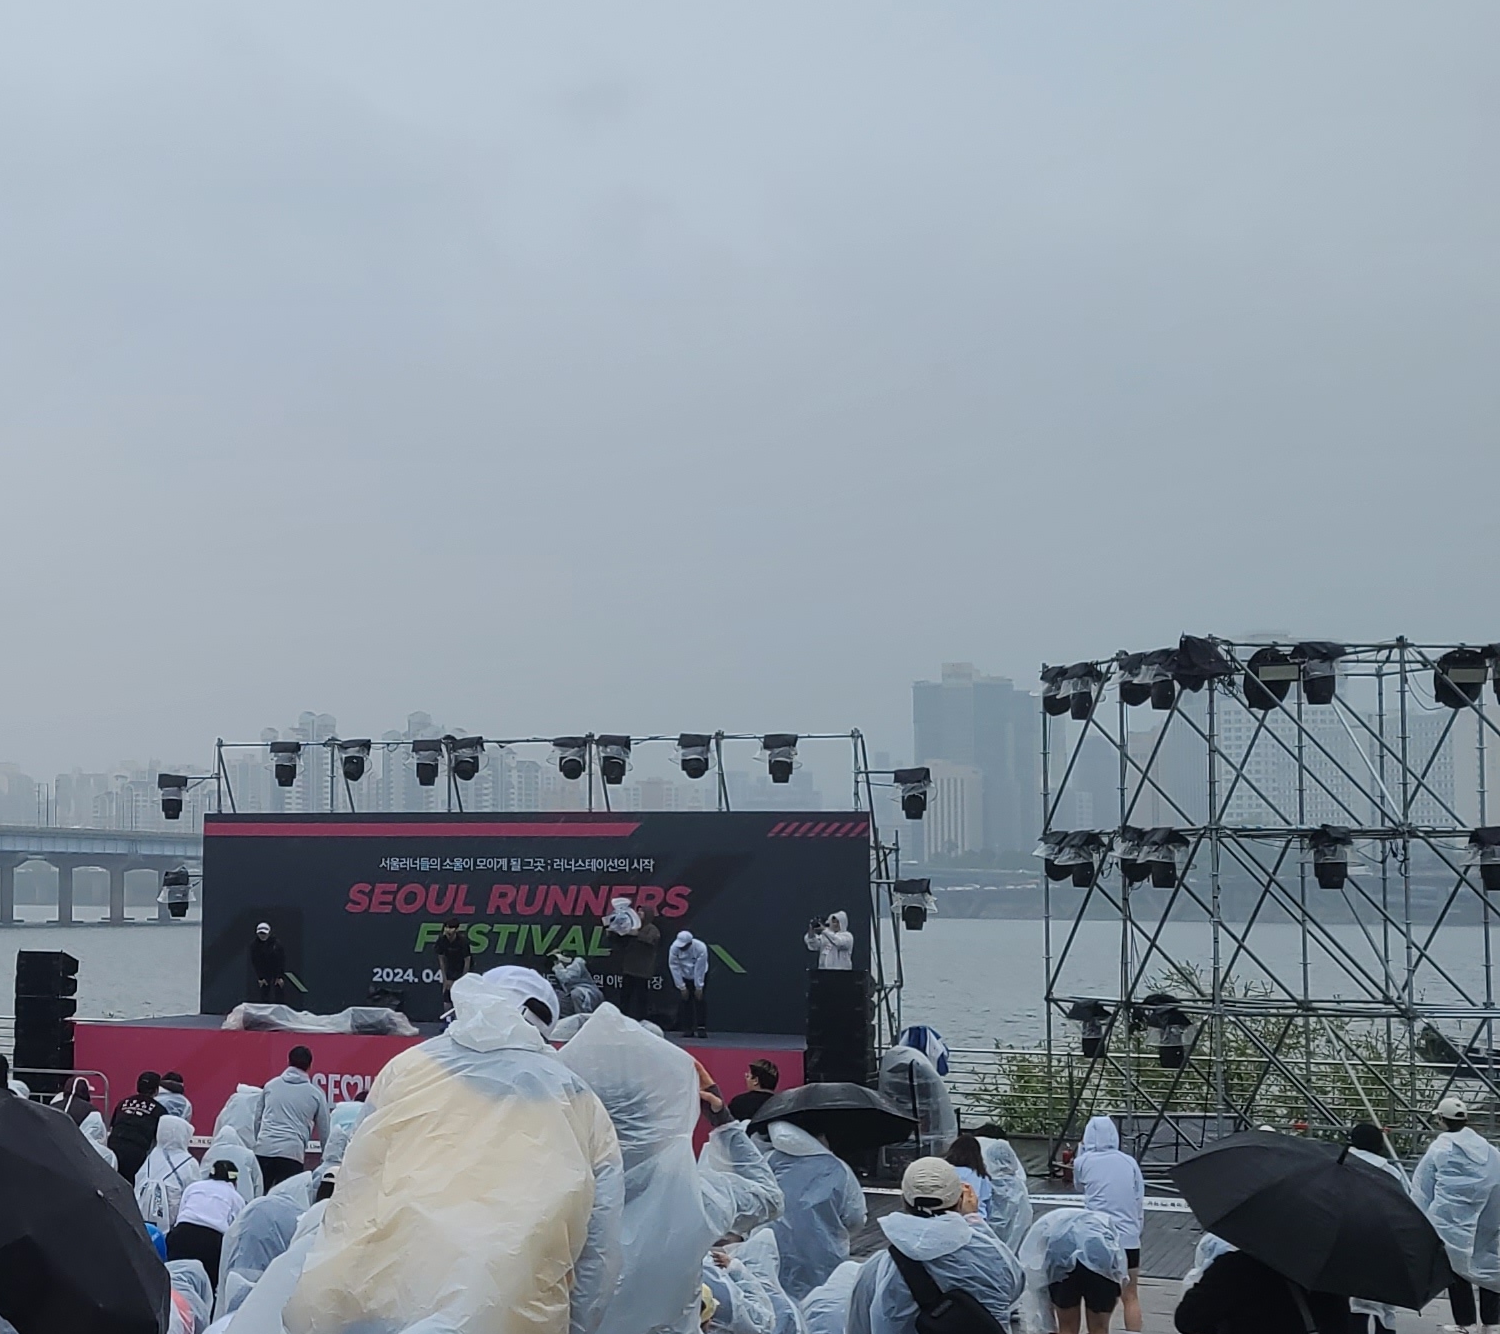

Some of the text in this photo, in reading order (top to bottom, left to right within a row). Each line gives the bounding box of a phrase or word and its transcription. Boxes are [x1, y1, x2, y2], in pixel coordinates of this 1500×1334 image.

[379, 857, 440, 871] 서울러너들의
[442, 857, 474, 871] 소울이
[475, 857, 508, 872] 모이게
[510, 858, 521, 872] 될
[553, 858, 629, 873] 러너스테이션의
[630, 858, 655, 873] 시작
[345, 882, 476, 914] SEOUL
[414, 922, 612, 957] FSTIVAL
[372, 967, 419, 983] 2024.
